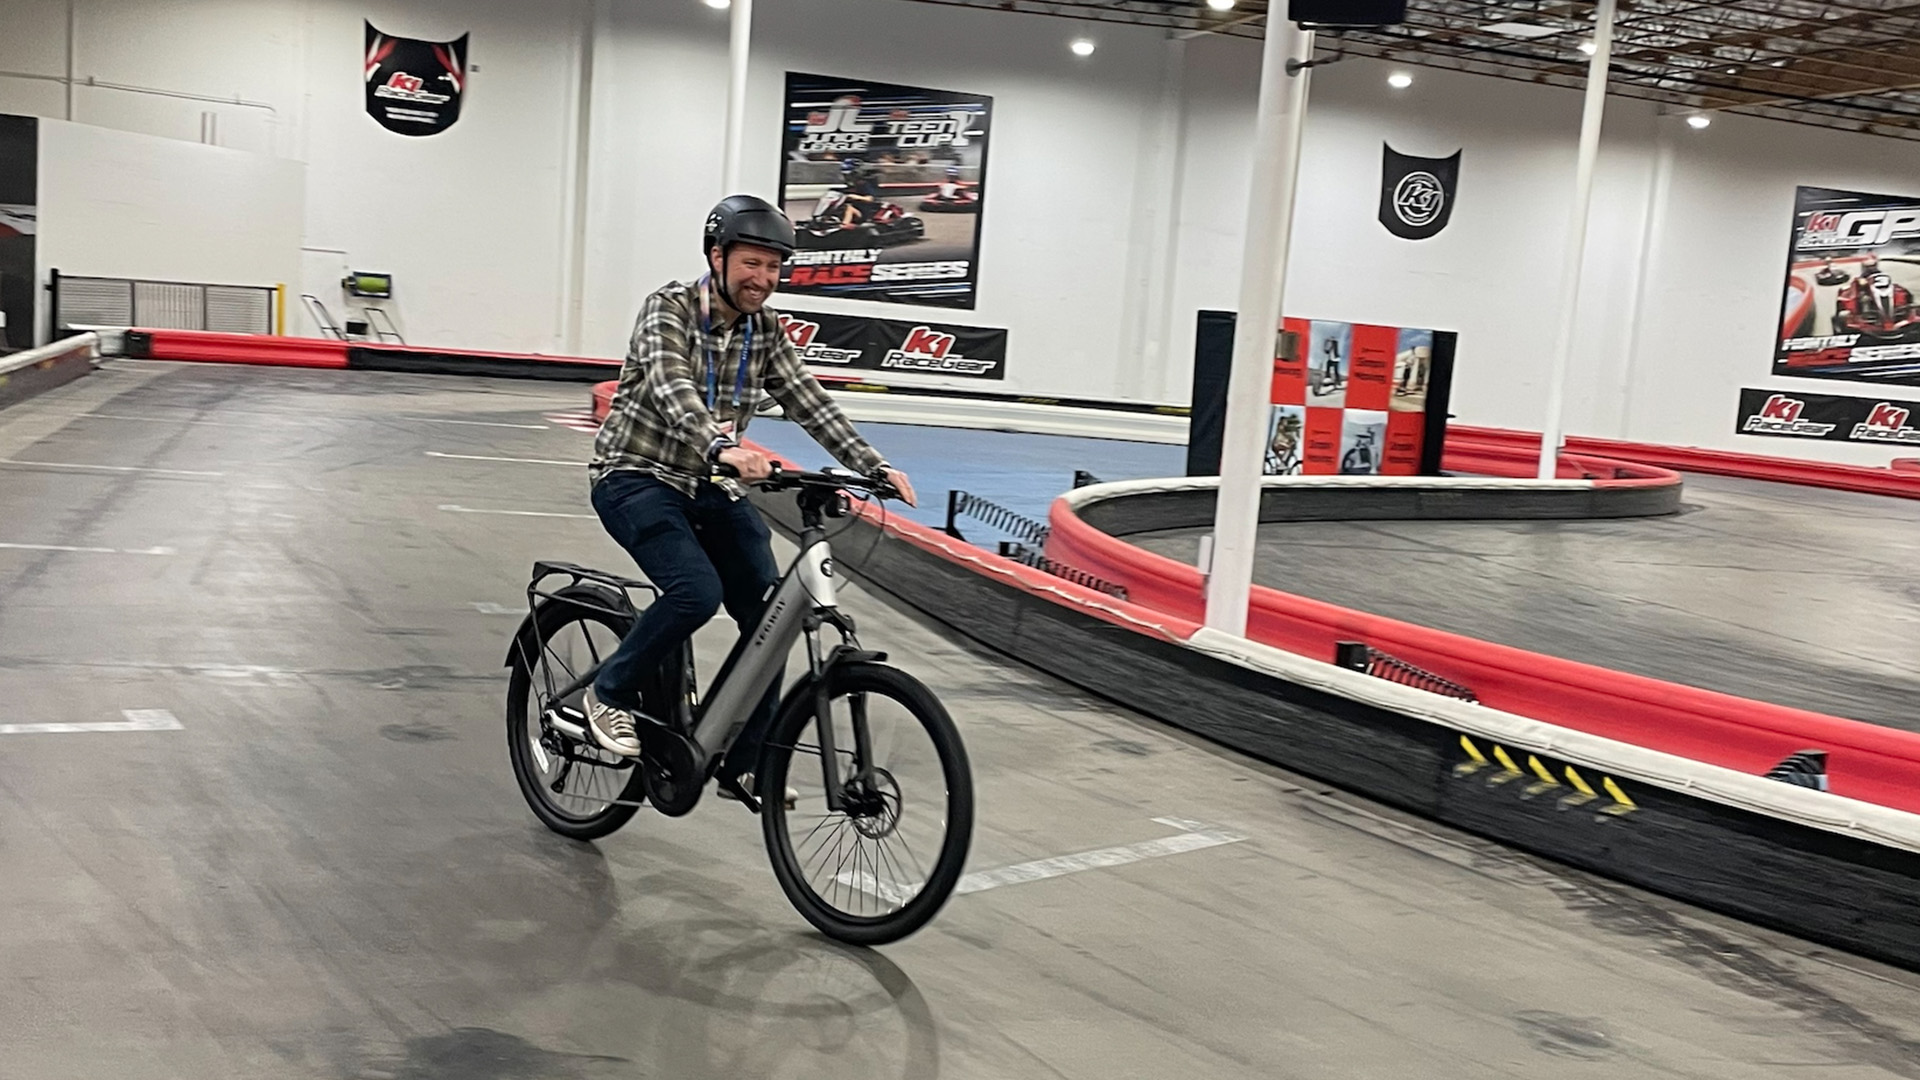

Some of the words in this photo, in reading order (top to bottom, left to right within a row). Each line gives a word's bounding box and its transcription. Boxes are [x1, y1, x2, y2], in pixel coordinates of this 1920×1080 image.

[887, 120, 957, 134] TEEN
[896, 134, 954, 147] CUP
[789, 264, 874, 286] RACE
[793, 344, 860, 362] eGear
[902, 328, 954, 358] K1
[884, 351, 994, 373] RaceGear
[1761, 396, 1803, 422] K1
[1866, 404, 1908, 430] K1
[1744, 416, 1835, 435] RaceGear
